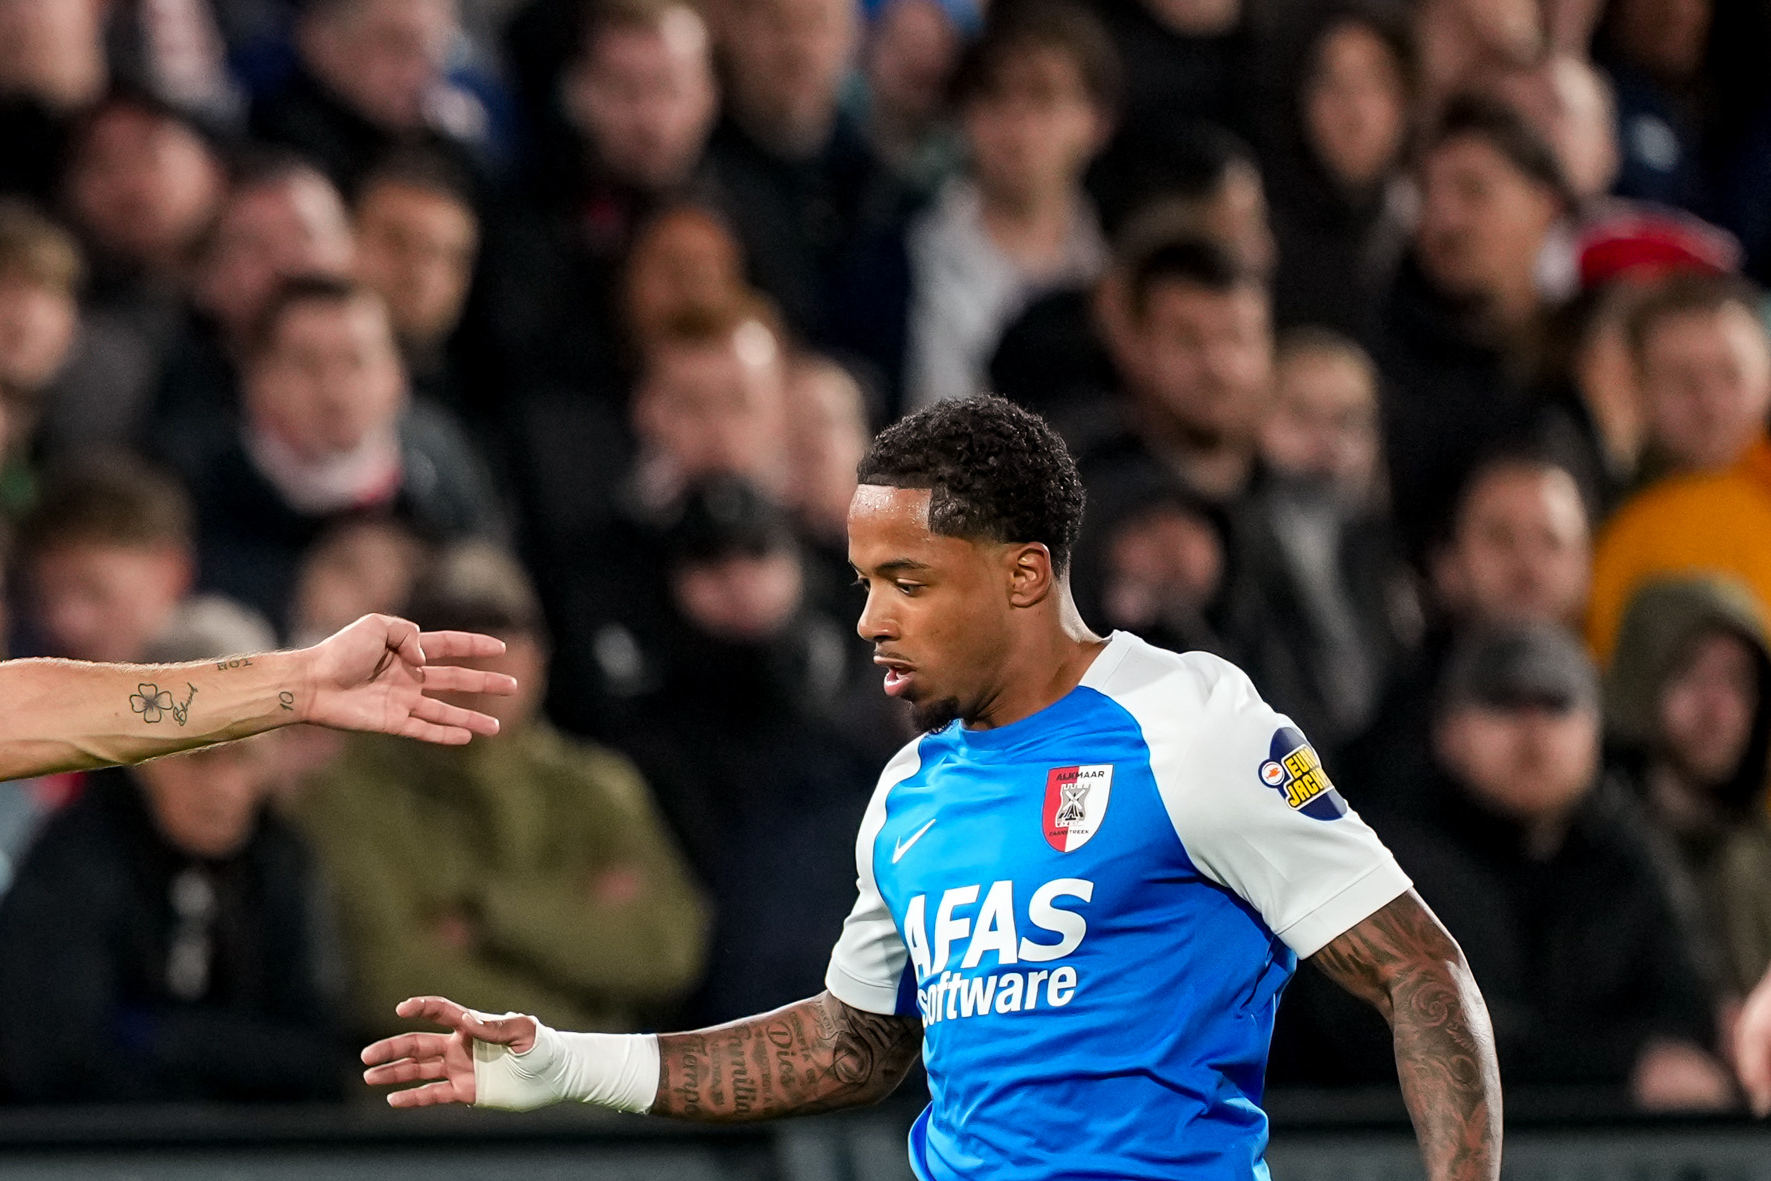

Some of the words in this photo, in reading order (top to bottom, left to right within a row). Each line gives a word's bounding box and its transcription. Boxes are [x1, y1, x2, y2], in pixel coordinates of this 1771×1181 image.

[278, 691, 294, 711] 10
[1056, 770, 1105, 781] ALKMAAR
[904, 878, 1095, 984] AFAS
[917, 965, 1078, 1029] software
